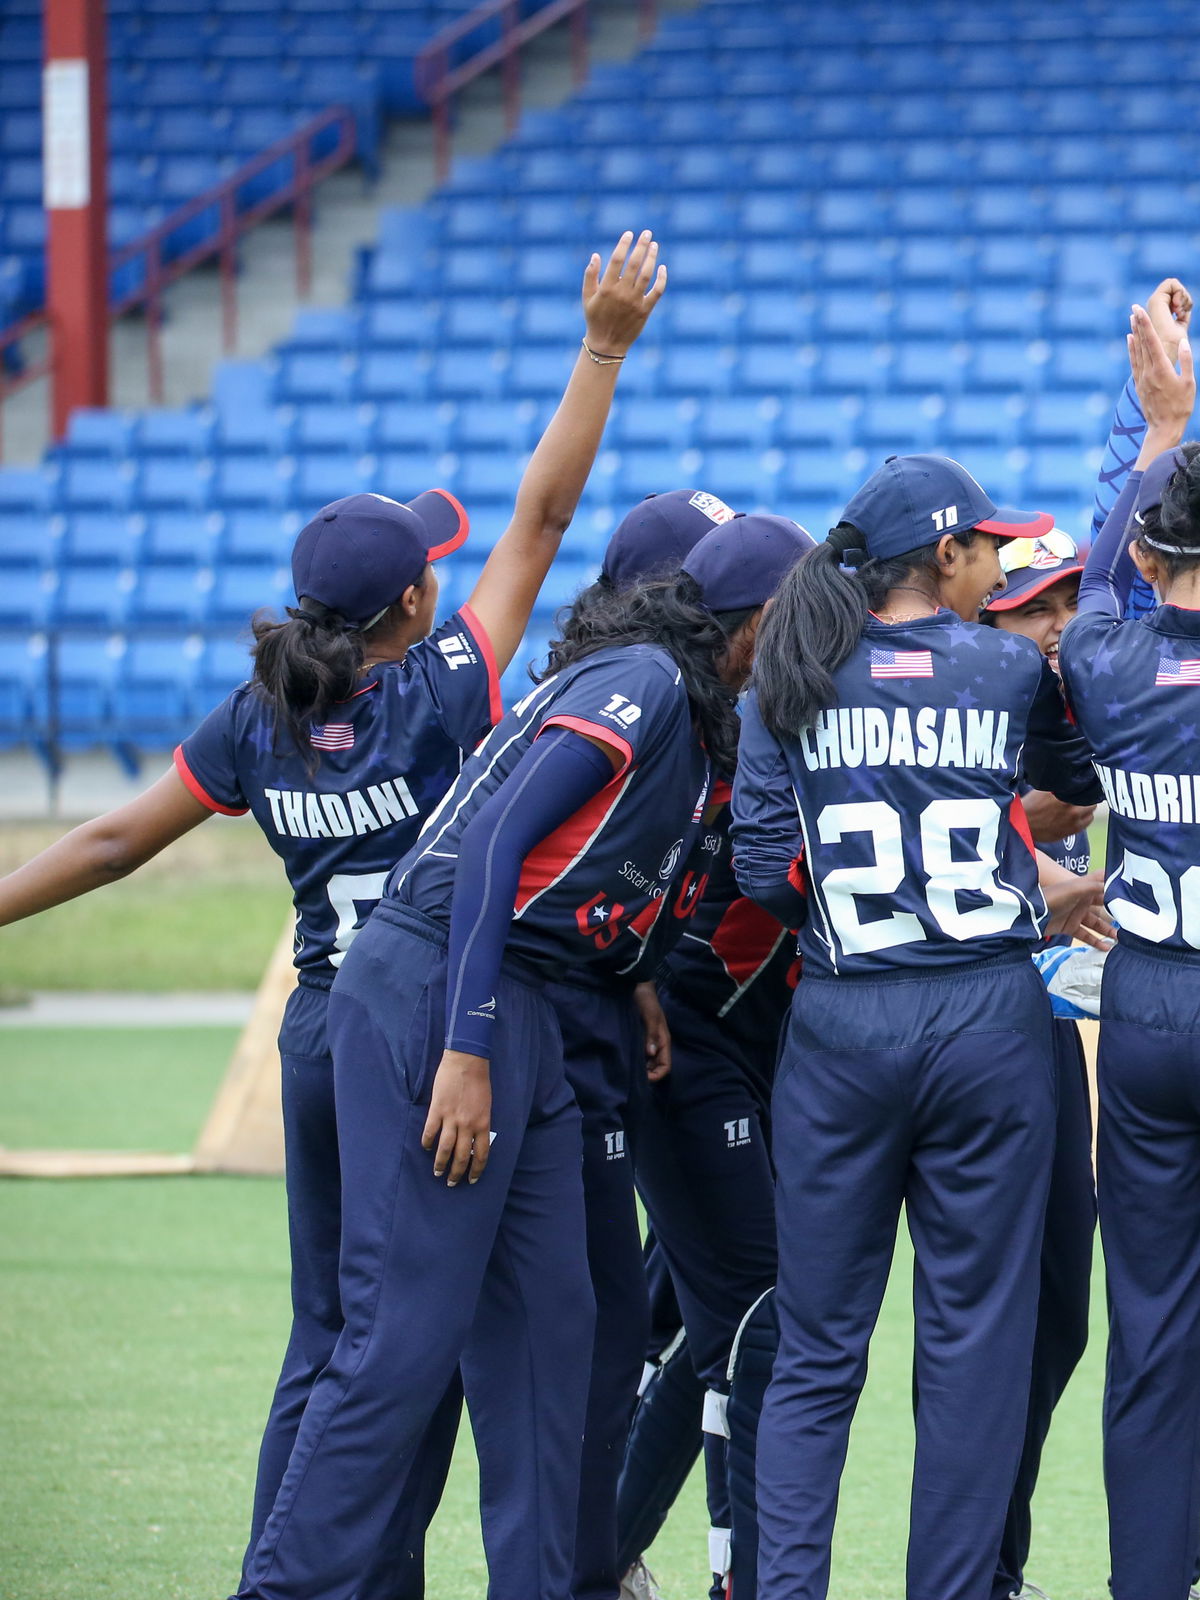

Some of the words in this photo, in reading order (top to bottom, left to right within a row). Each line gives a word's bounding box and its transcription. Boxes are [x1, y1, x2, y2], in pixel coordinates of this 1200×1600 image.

[802, 707, 1009, 772] CHUDASAMA
[264, 776, 420, 839] THADANI
[618, 860, 648, 891] Sistar
[816, 798, 1021, 956] 28
